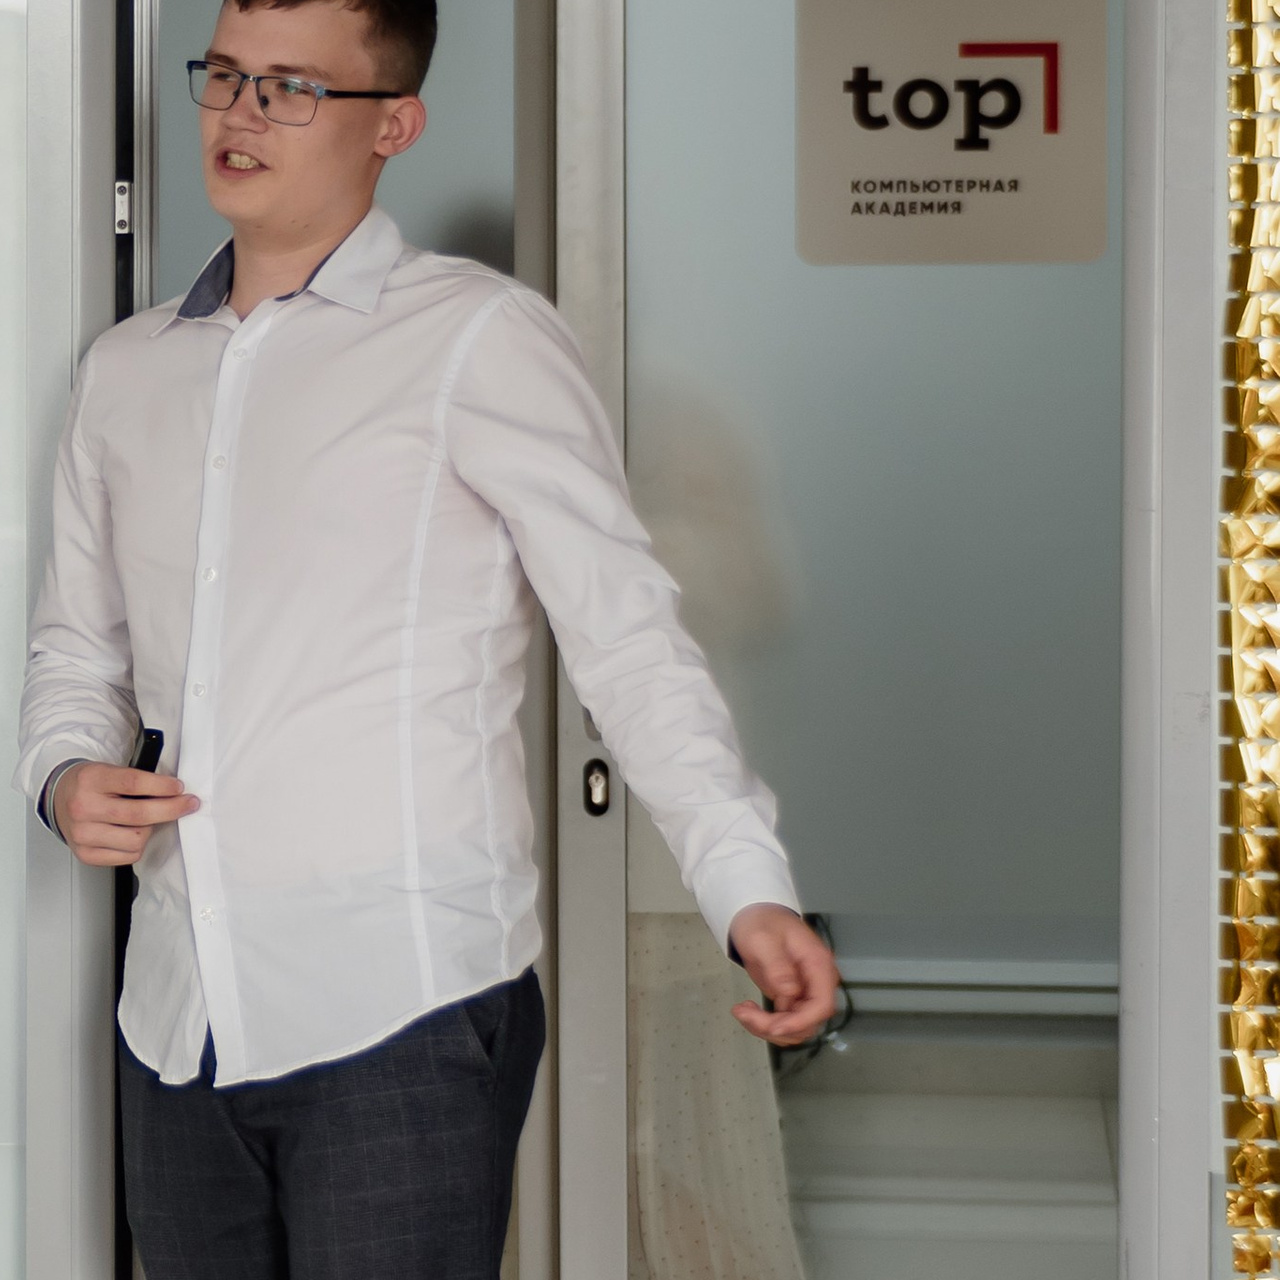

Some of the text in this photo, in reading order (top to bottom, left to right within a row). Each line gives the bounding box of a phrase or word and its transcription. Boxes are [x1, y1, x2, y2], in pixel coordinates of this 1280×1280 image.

[842, 66, 1022, 151] top
[850, 179, 1020, 194] КОМПЬЮТЕРНАЯ
[850, 201, 963, 217] АКАДЕМИЯ
